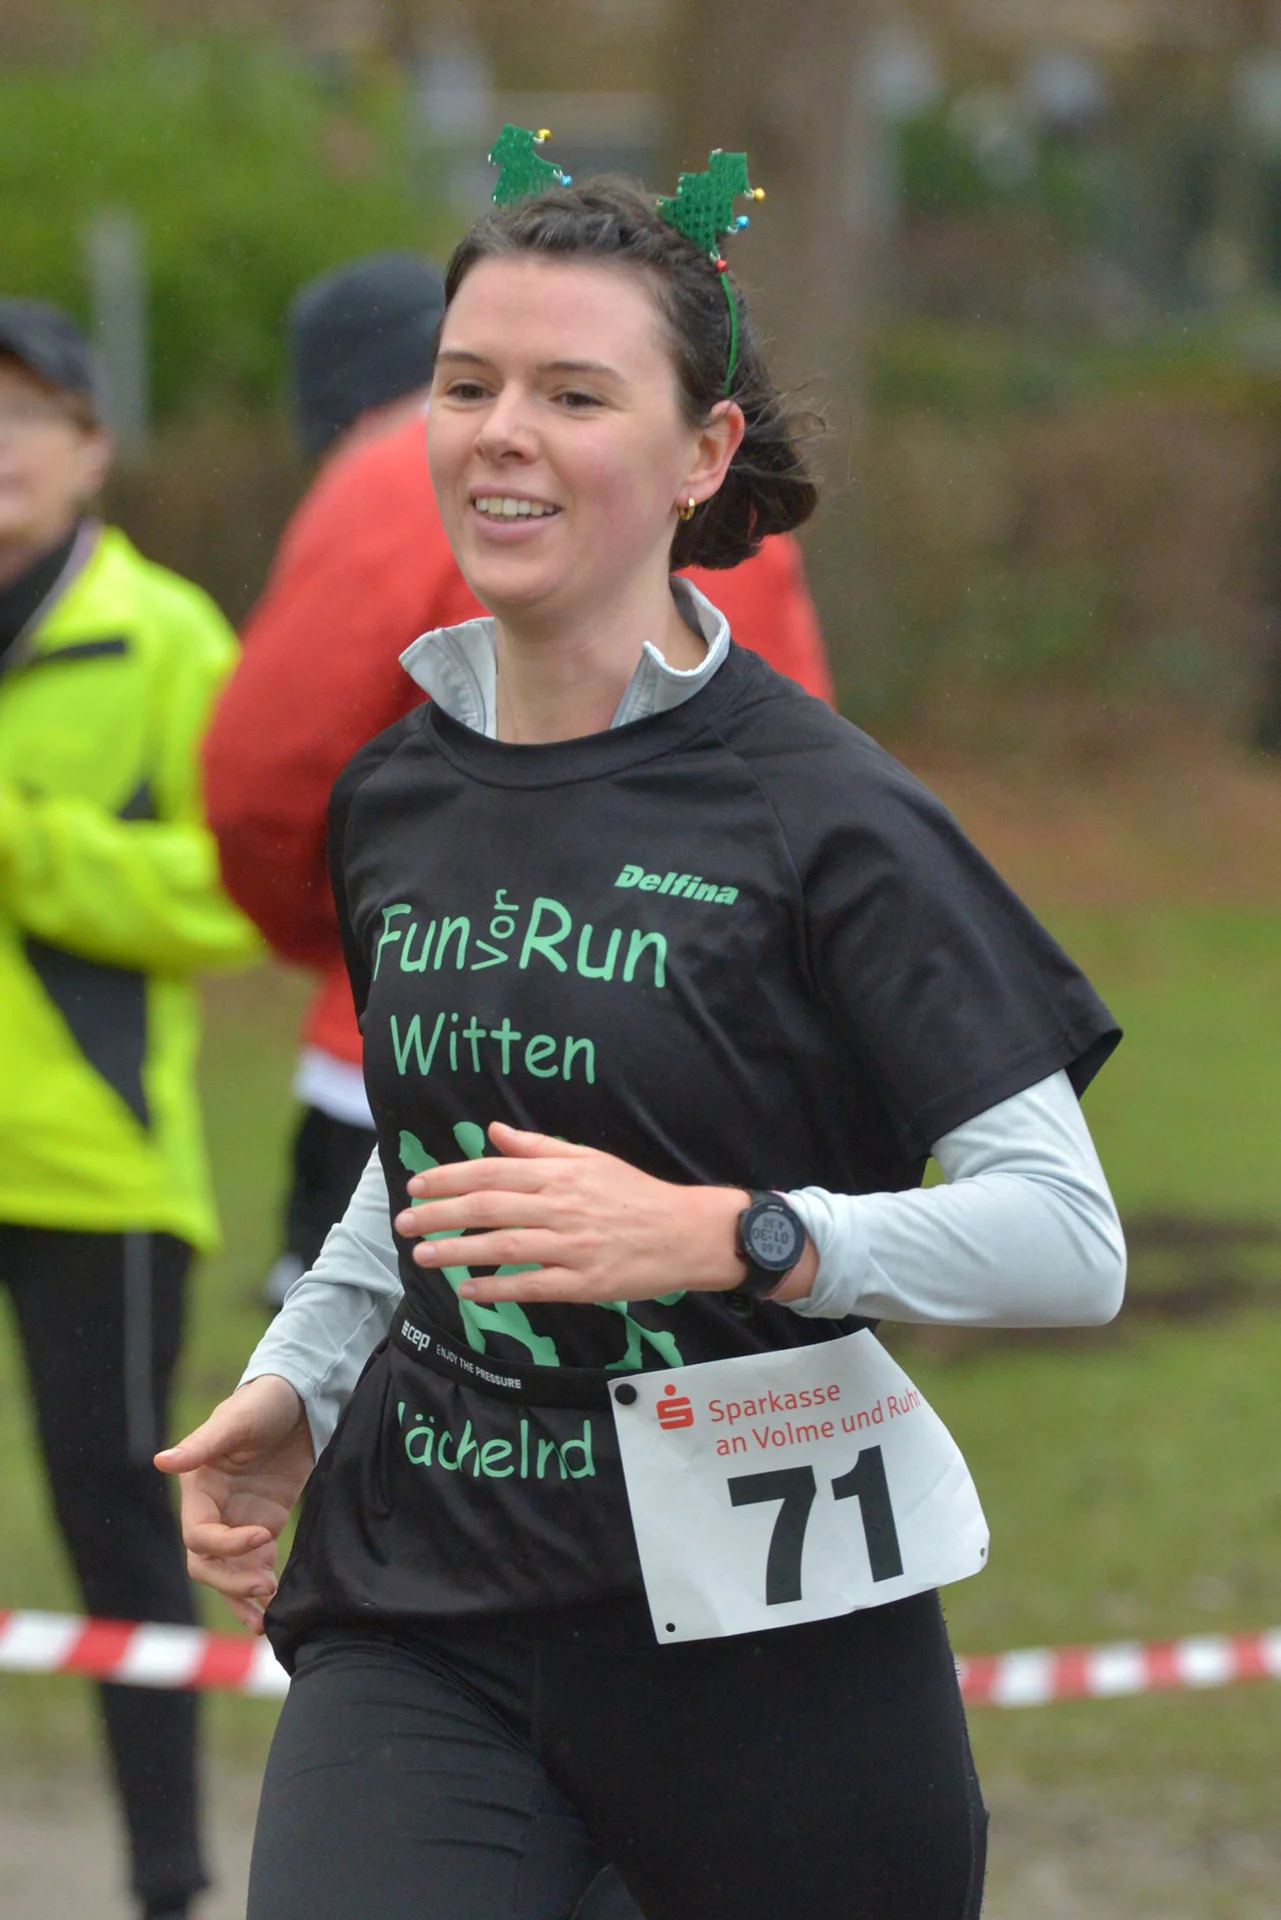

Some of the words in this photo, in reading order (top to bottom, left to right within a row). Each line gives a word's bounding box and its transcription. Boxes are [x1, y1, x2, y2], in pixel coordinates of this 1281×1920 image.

[614, 864, 740, 905] Delfina
[373, 903, 471, 982] Fun
[519, 897, 667, 988] Run
[390, 1012, 595, 1084] Witten
[435, 1343, 458, 1366] ENJOY
[459, 1357, 475, 1375] THE
[475, 1365, 522, 1390] PRESSURE
[708, 1384, 841, 1426] Sparkasse
[716, 1435, 748, 1457] an
[752, 1421, 835, 1450] Volme
[841, 1399, 884, 1434] und
[727, 1444, 905, 1606] 71
